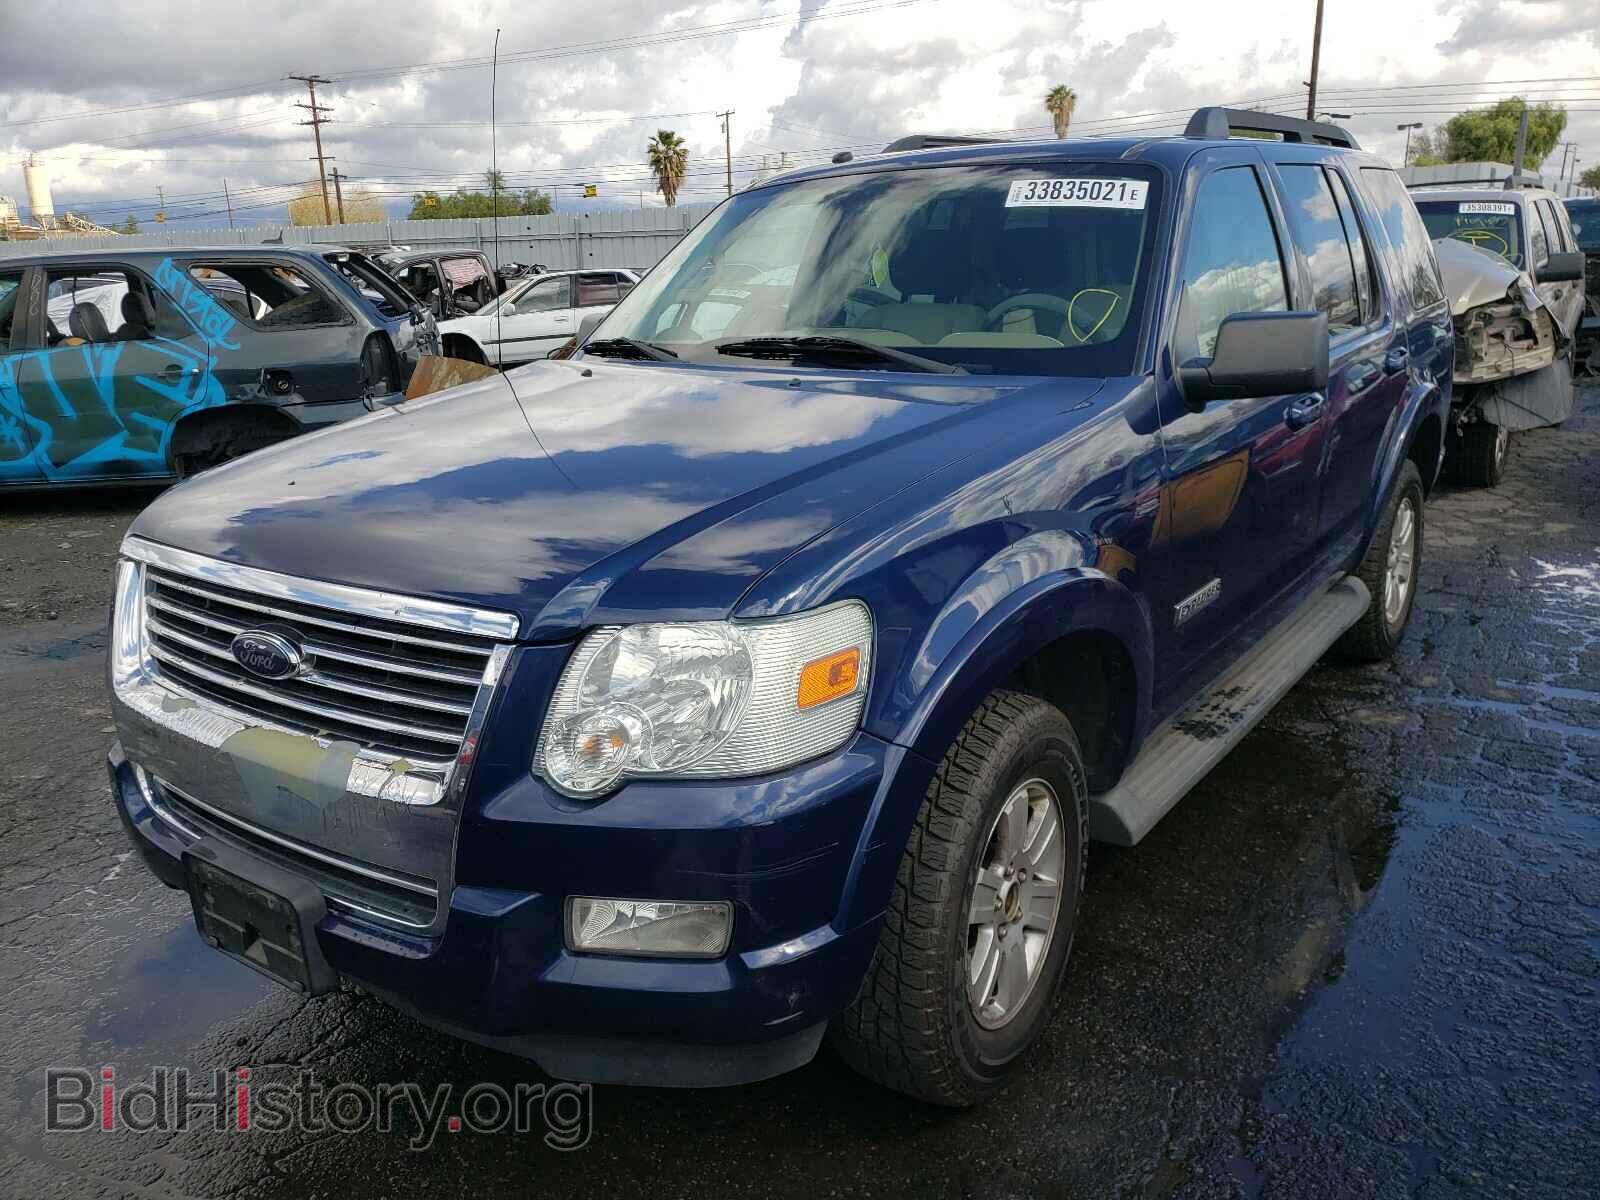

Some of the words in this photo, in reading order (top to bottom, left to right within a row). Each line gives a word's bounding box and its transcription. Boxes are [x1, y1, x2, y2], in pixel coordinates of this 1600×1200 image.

[1024, 180, 1127, 202] 33835021
[1130, 189, 1140, 201] E
[240, 639, 277, 671] Ford
